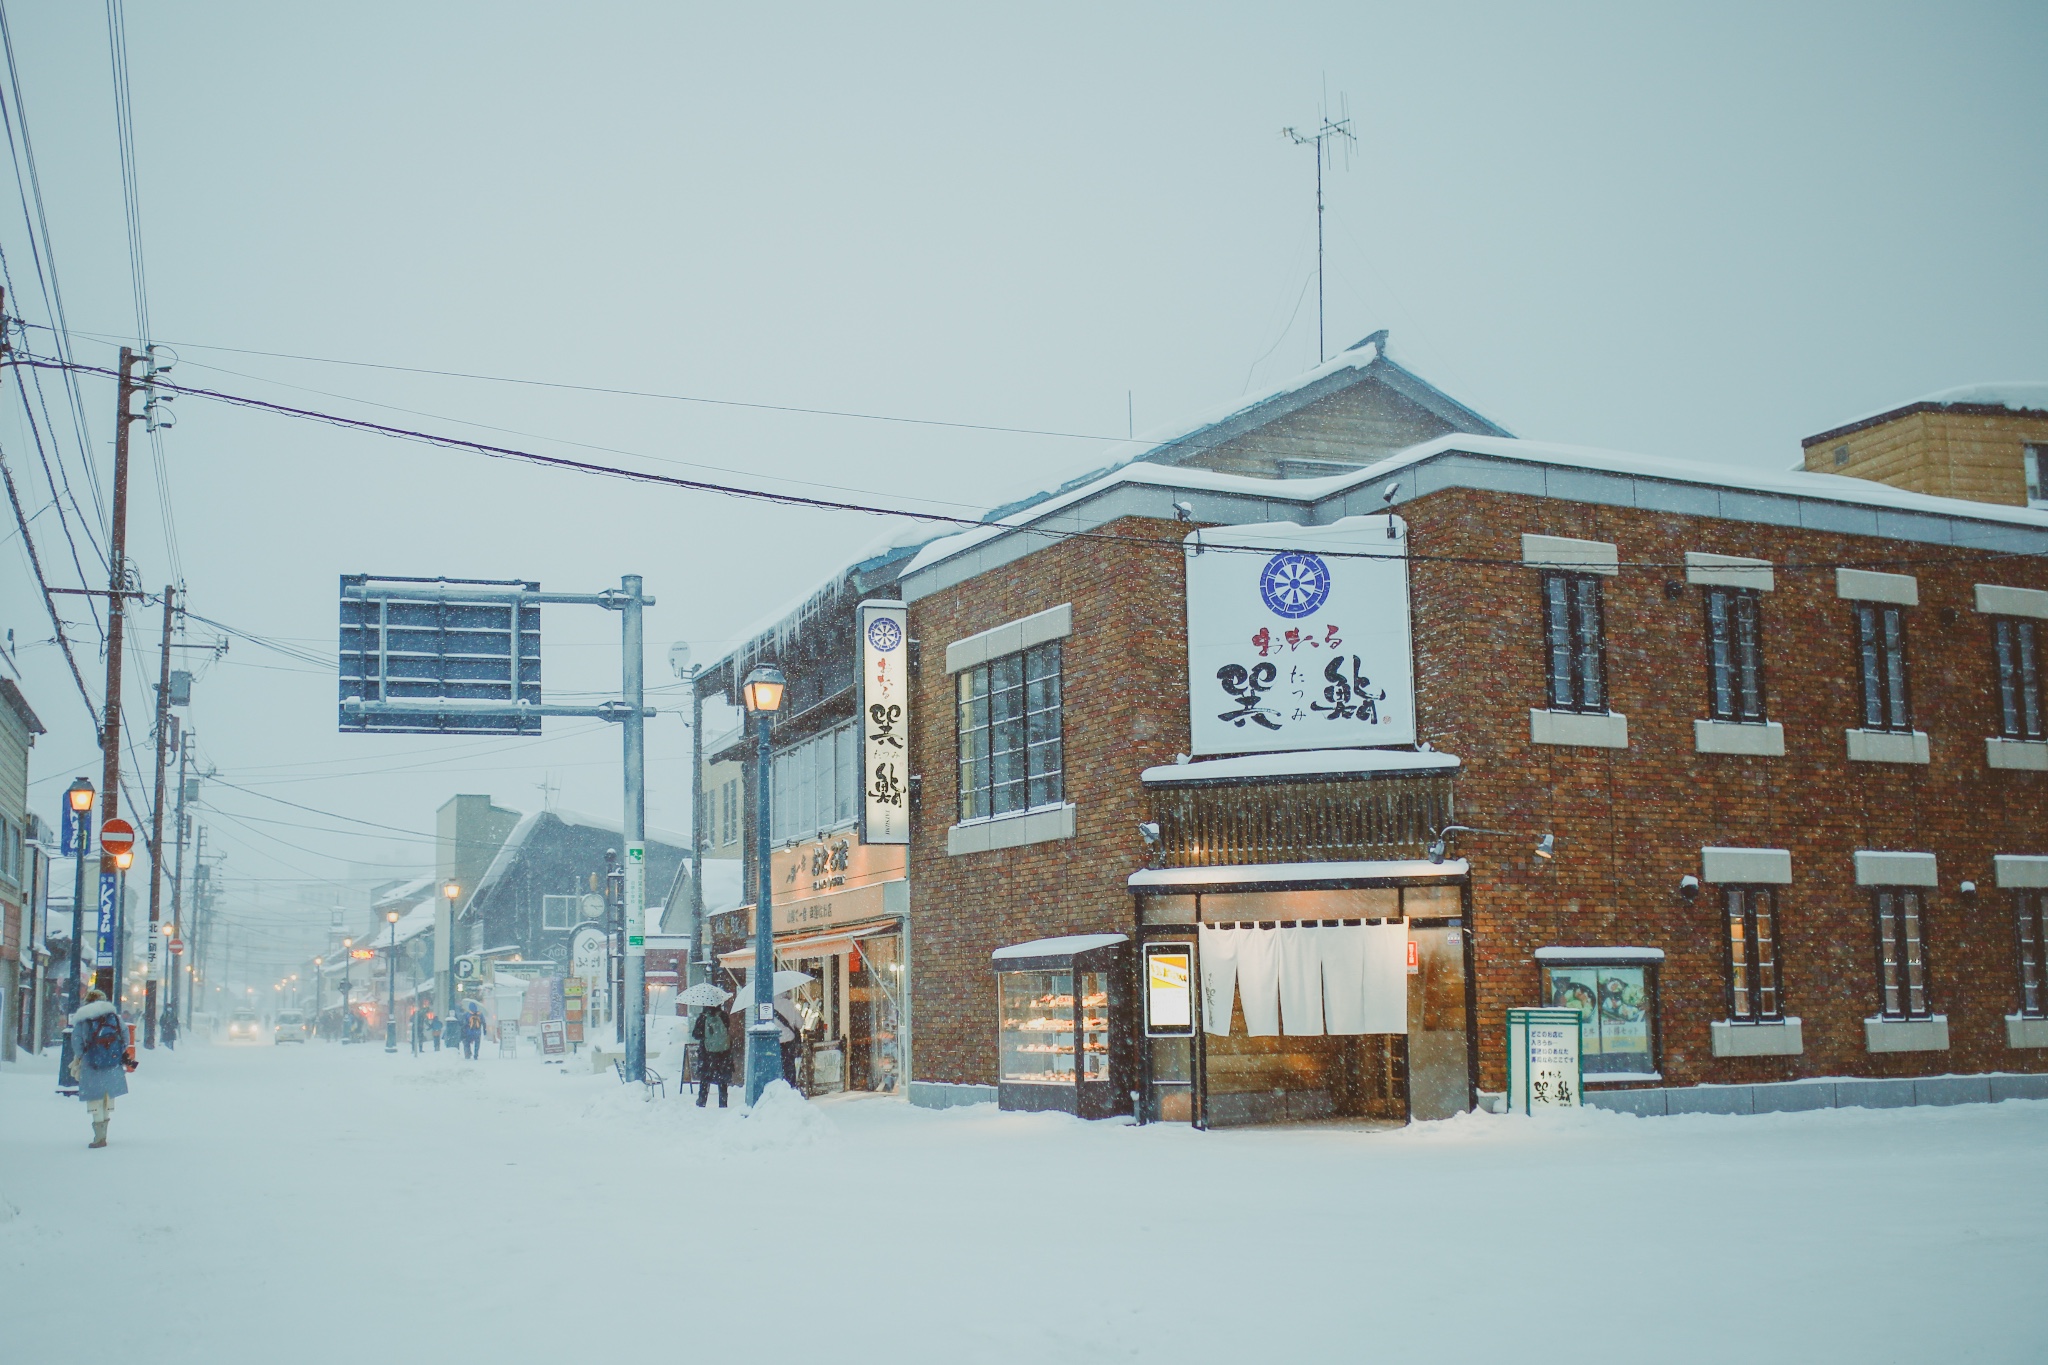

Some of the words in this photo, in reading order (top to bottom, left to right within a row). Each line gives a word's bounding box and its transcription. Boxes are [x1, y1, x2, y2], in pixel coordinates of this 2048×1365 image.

[1289, 664, 1307, 722] たつみ
[459, 961, 471, 976] P
